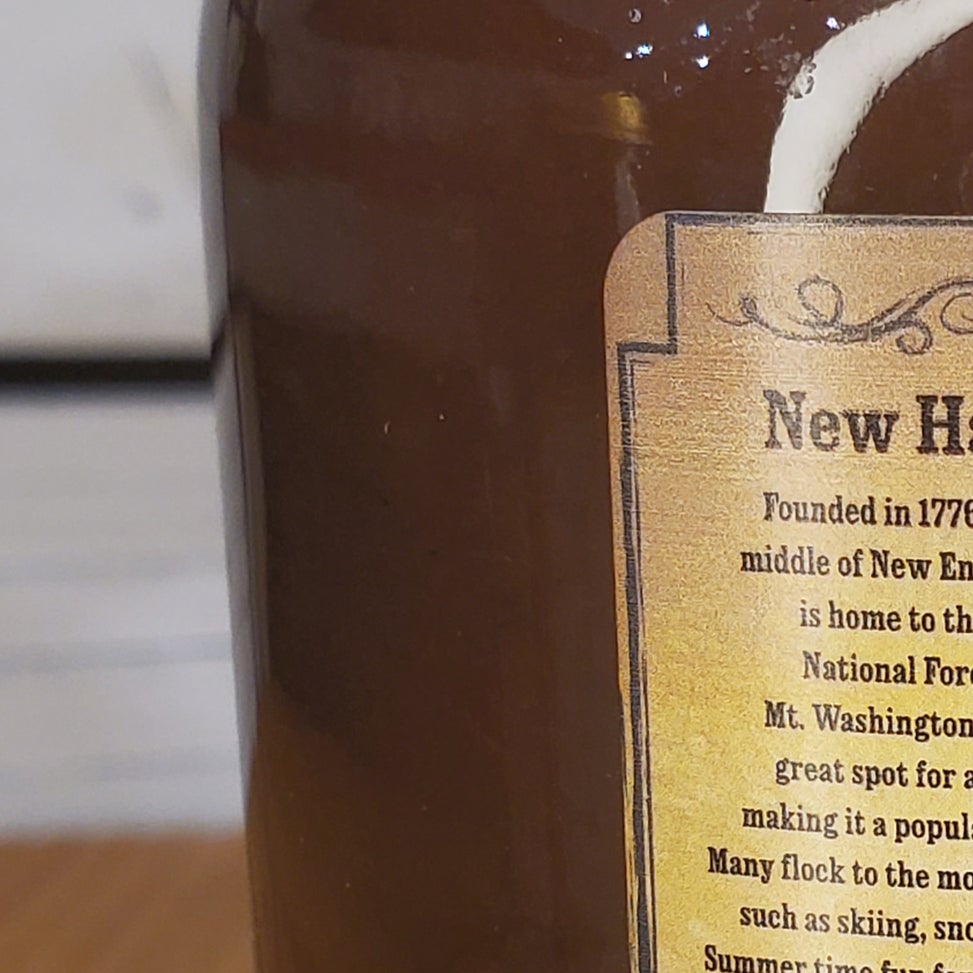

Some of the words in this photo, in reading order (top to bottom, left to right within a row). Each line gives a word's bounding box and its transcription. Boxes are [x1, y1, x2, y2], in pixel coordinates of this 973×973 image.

[763, 390, 899, 453] New
[763, 492, 877, 525] Founded
[740, 545, 829, 575] middle
[870, 549, 932, 580] New
[829, 600, 901, 631] home
[803, 651, 916, 684] National
[764, 700, 804, 729] Mt.
[776, 758, 844, 785] great
[852, 763, 908, 791] spot
[916, 760, 956, 789] for
[742, 802, 838, 839] making
[707, 846, 774, 884] Many
[781, 854, 845, 884] flock
[885, 860, 929, 889] the
[740, 903, 797, 930] such
[838, 908, 926, 944] skiing,
